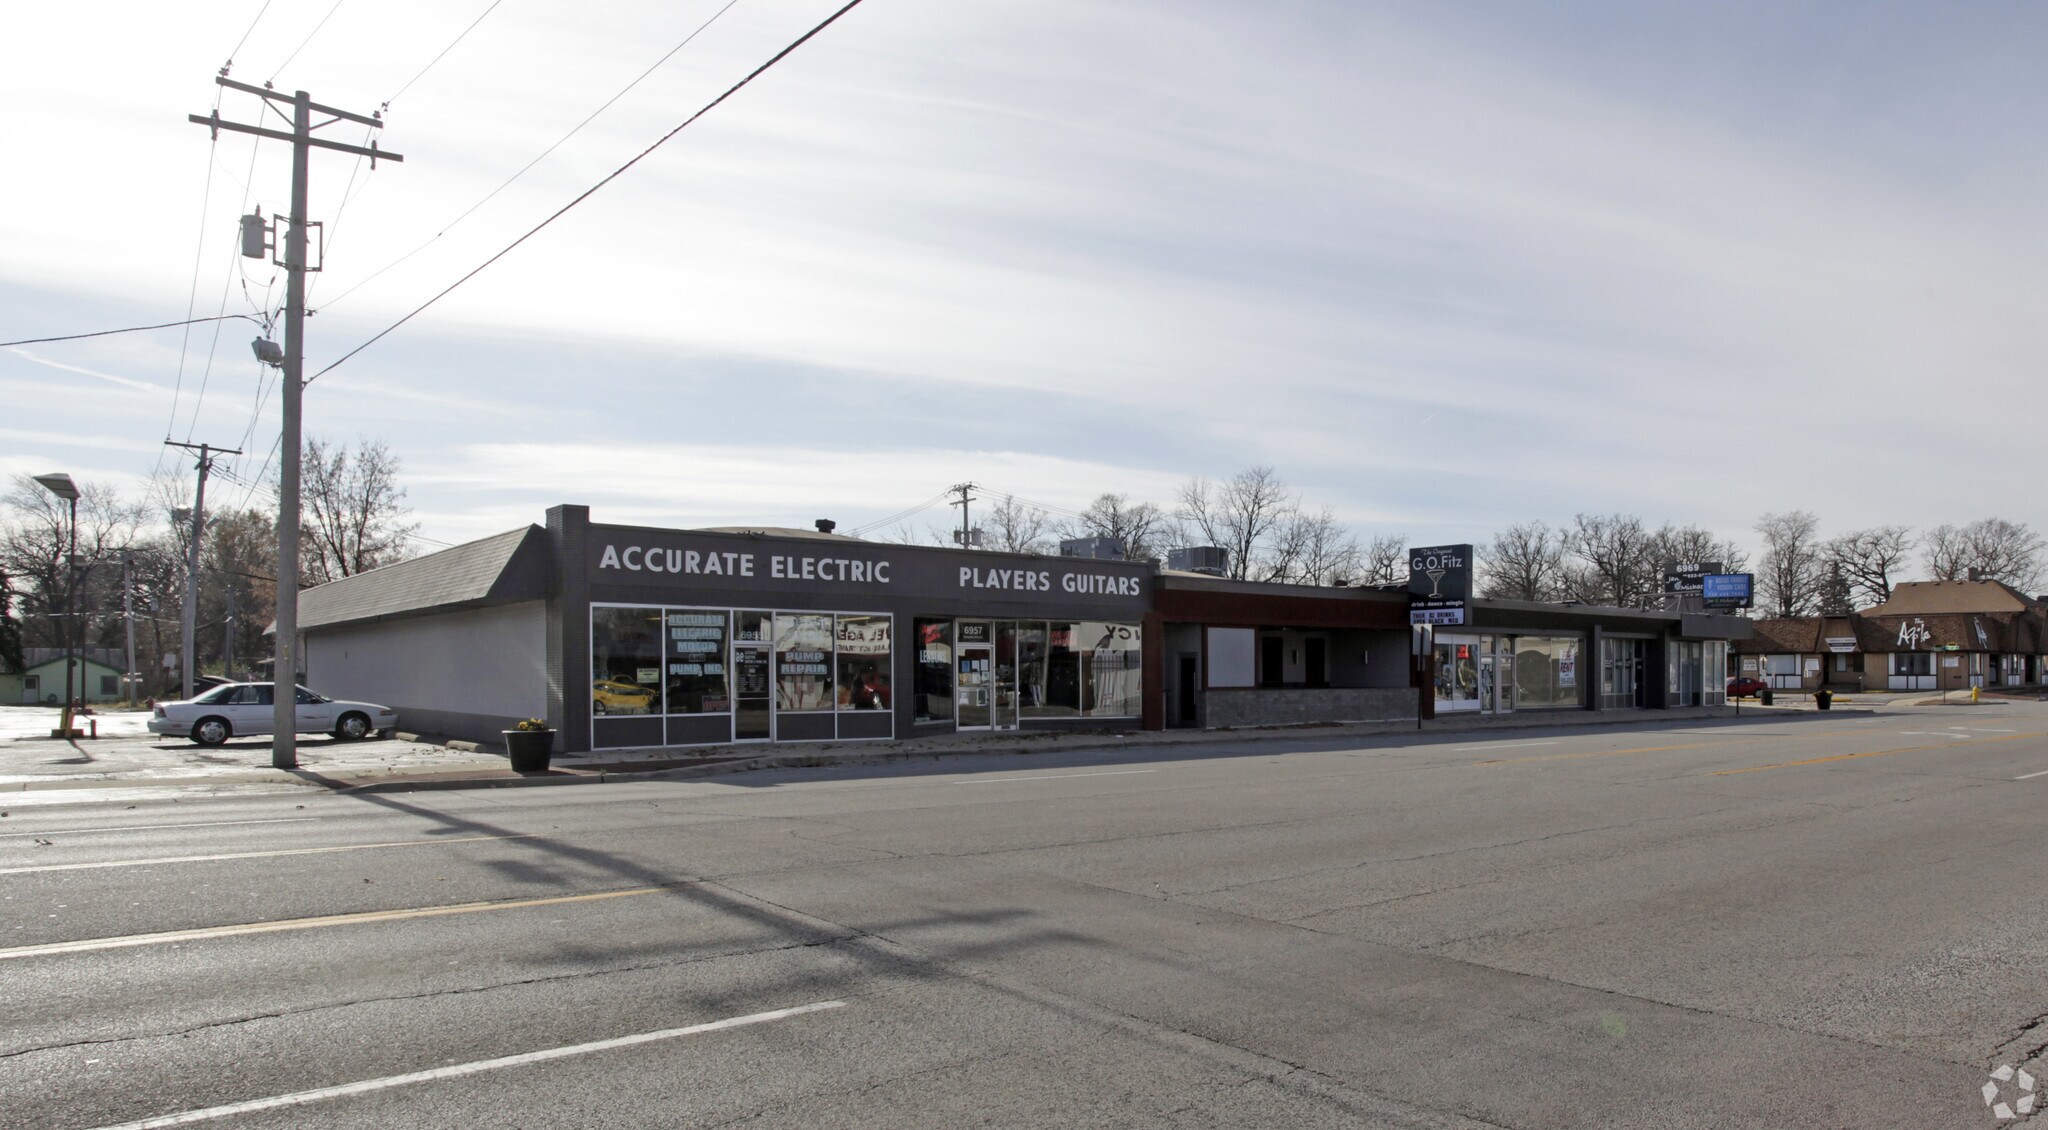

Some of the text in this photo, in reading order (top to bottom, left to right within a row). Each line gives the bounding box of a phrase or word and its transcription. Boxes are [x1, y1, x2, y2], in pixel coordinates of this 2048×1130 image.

[599, 545, 890, 583] ACCURATE ELECTRIC
[1676, 564, 1700, 573] 6969
[959, 567, 1140, 596] PLAYERS GUITARS
[668, 614, 725, 626] ACCURATE
[671, 627, 722, 639] ELECTRIC
[964, 626, 983, 635] 6957
[677, 641, 718, 652] MOTOR
[689, 653, 706, 662] AND
[785, 651, 825, 662] PUMP
[919, 649, 947, 664] LESSONS
[780, 663, 828, 675] REPAIR
[1560, 662, 1574, 673] RENT
